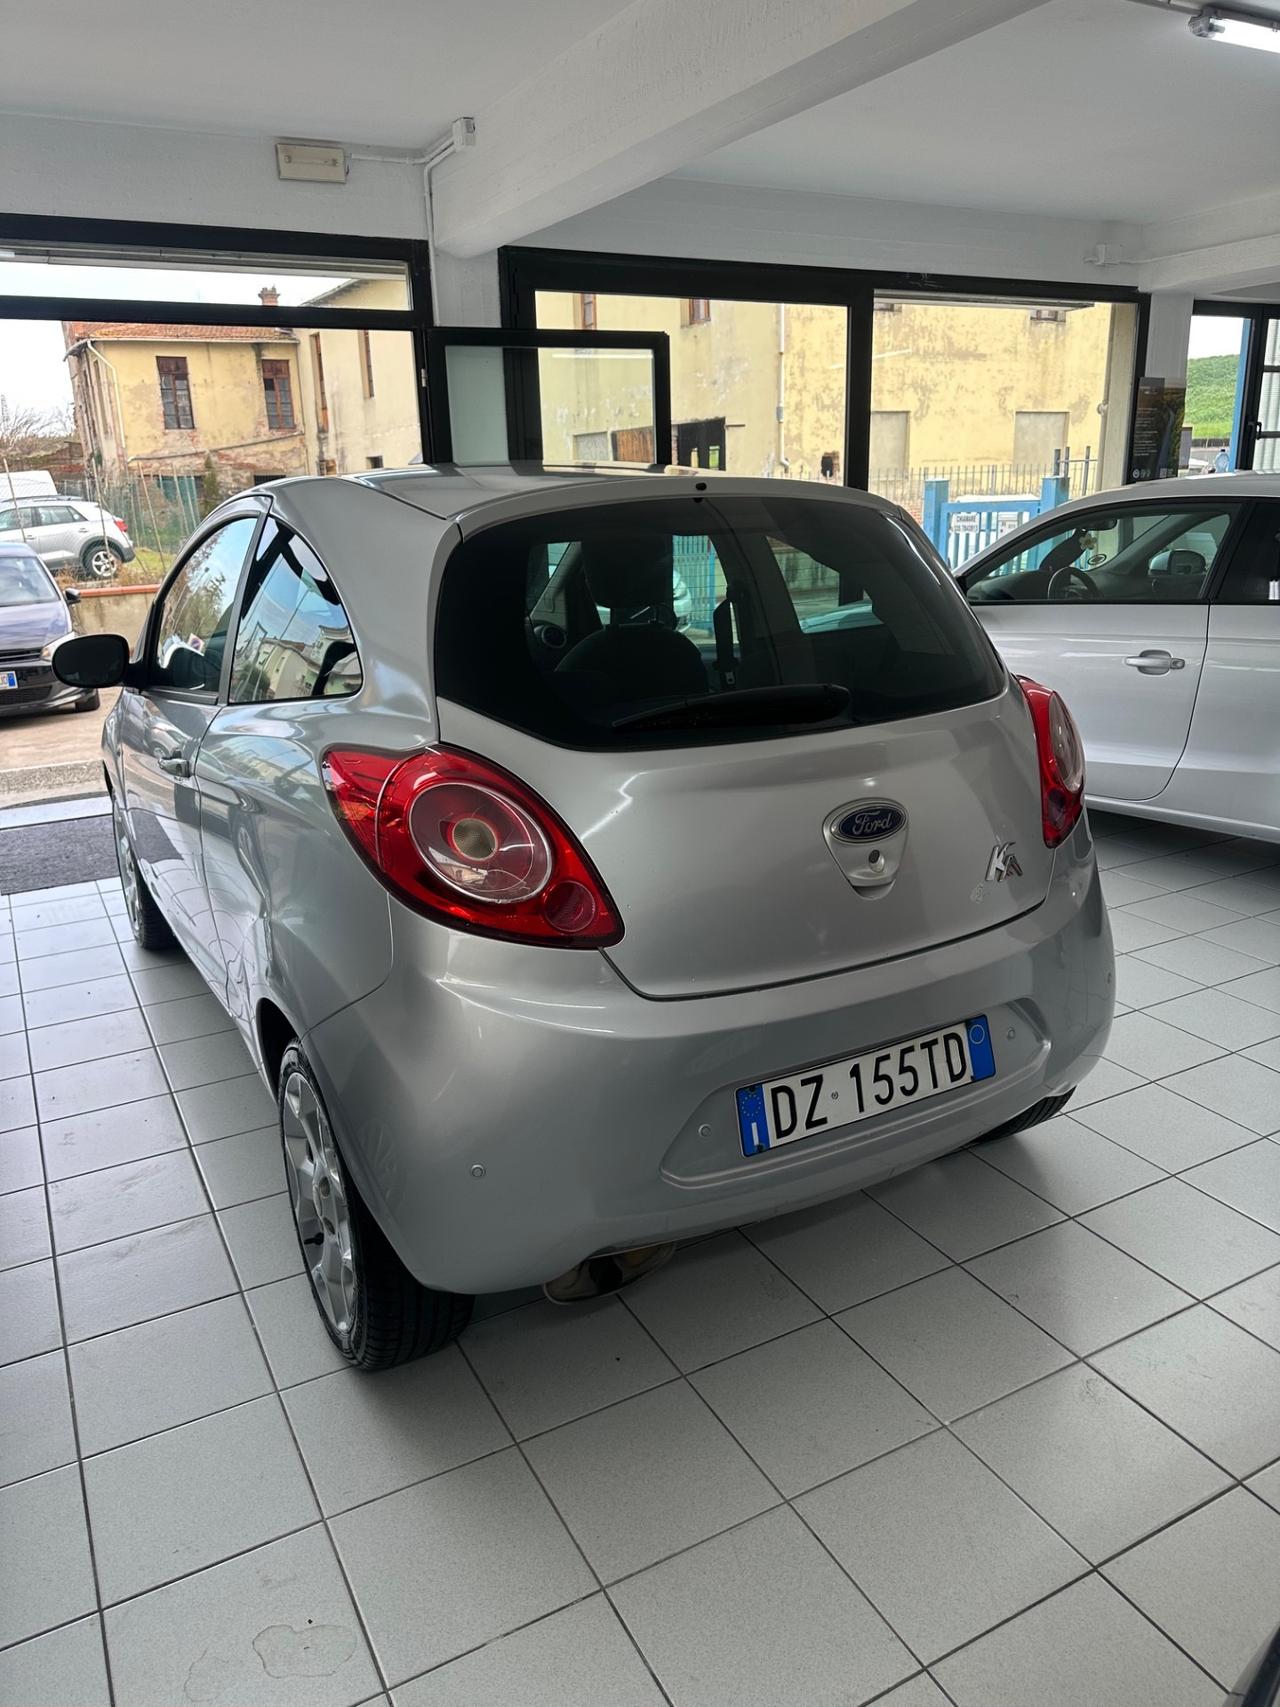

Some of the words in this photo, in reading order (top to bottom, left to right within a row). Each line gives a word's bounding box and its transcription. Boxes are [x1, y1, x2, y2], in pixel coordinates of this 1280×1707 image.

[852, 810, 893, 836] Ford
[770, 1074, 828, 1140] DZ
[849, 1032, 968, 1113] 155TD
